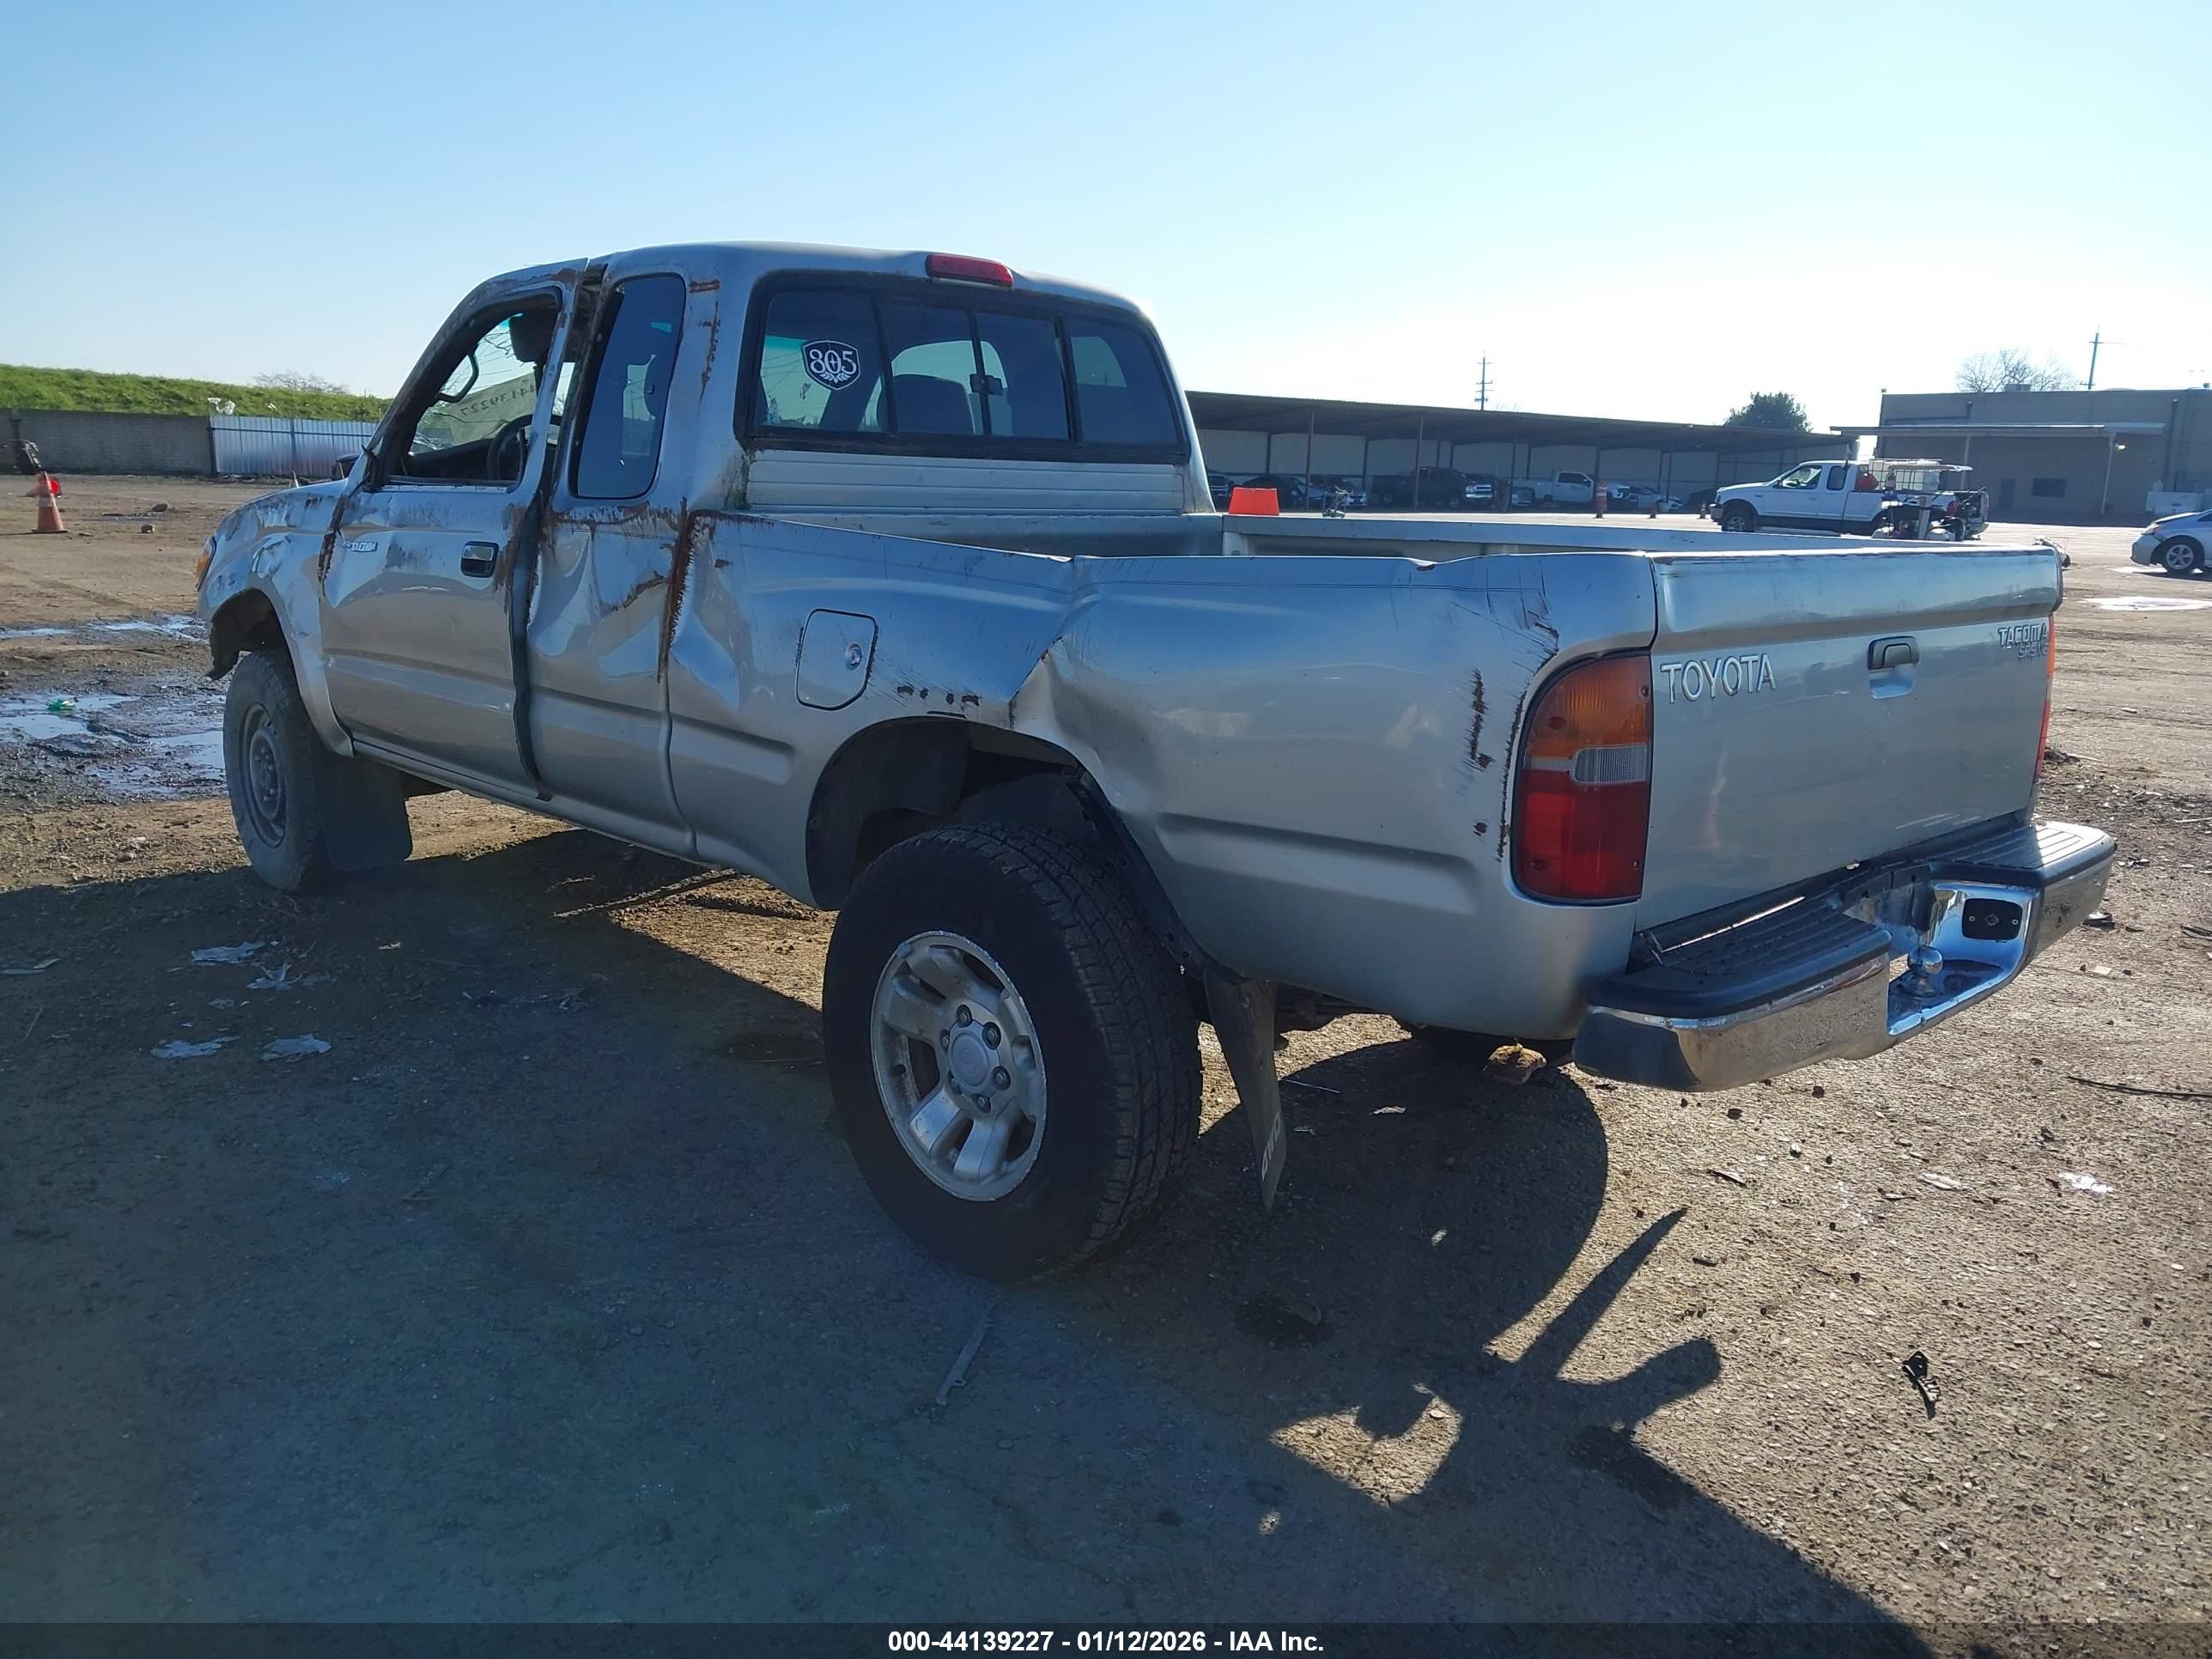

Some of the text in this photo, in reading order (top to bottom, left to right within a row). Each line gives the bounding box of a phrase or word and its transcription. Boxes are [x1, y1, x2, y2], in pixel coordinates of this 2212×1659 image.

[809, 349, 857, 375] 805
[1997, 623, 2049, 648] TACOMA
[1660, 653, 1777, 704] TOYOTA
